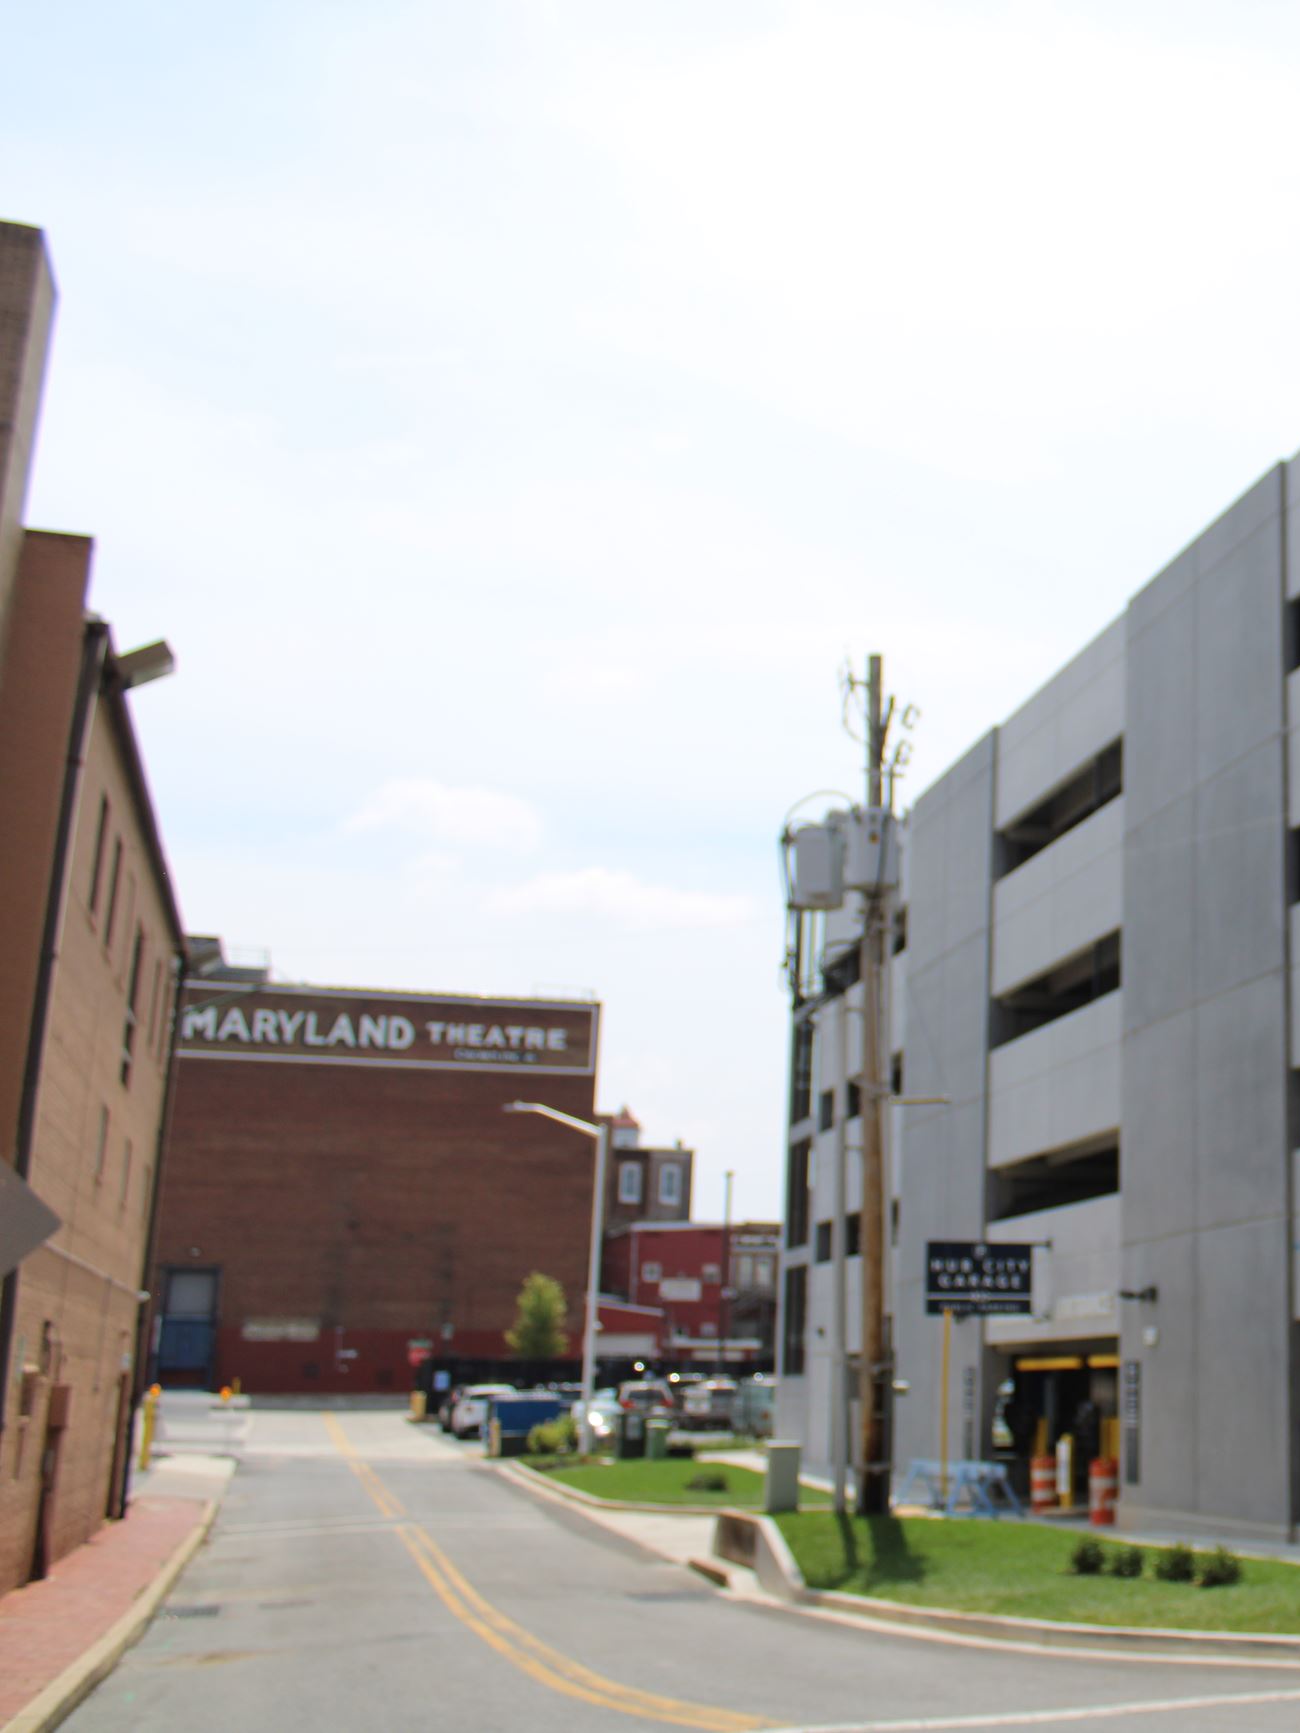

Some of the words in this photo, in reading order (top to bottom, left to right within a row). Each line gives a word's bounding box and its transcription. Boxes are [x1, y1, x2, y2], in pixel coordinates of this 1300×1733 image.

[181, 1005, 416, 1050] MARYLAND
[425, 1020, 568, 1051] THEATRE
[982, 1257, 1029, 1274] CITY
[937, 1273, 1021, 1289] GARAGE
